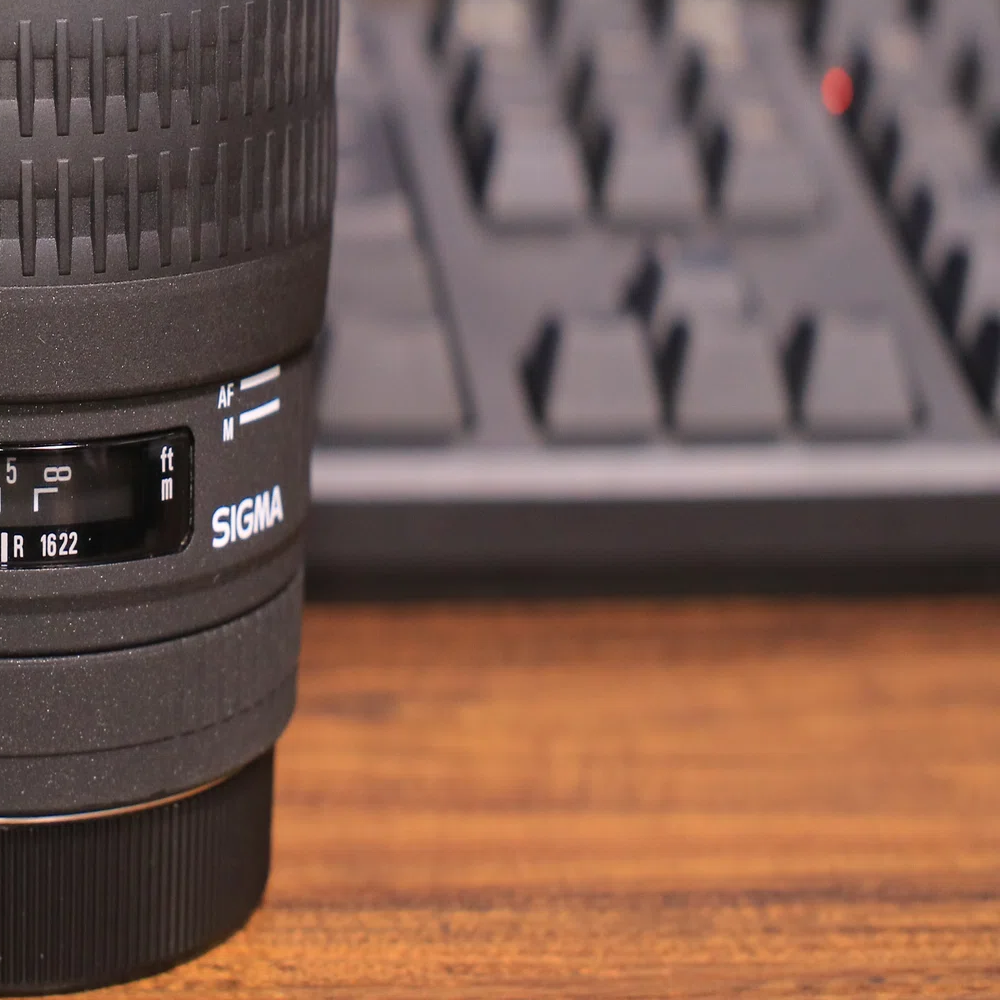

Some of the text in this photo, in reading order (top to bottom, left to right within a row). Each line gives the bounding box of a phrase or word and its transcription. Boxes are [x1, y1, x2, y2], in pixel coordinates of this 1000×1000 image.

[217, 383, 235, 409] AF
[222, 416, 235, 442] M
[6, 457, 18, 484] 5
[160, 446, 174, 473] ft
[161, 477, 173, 501] m
[212, 485, 284, 549] SIGMA
[13, 534, 24, 558] R
